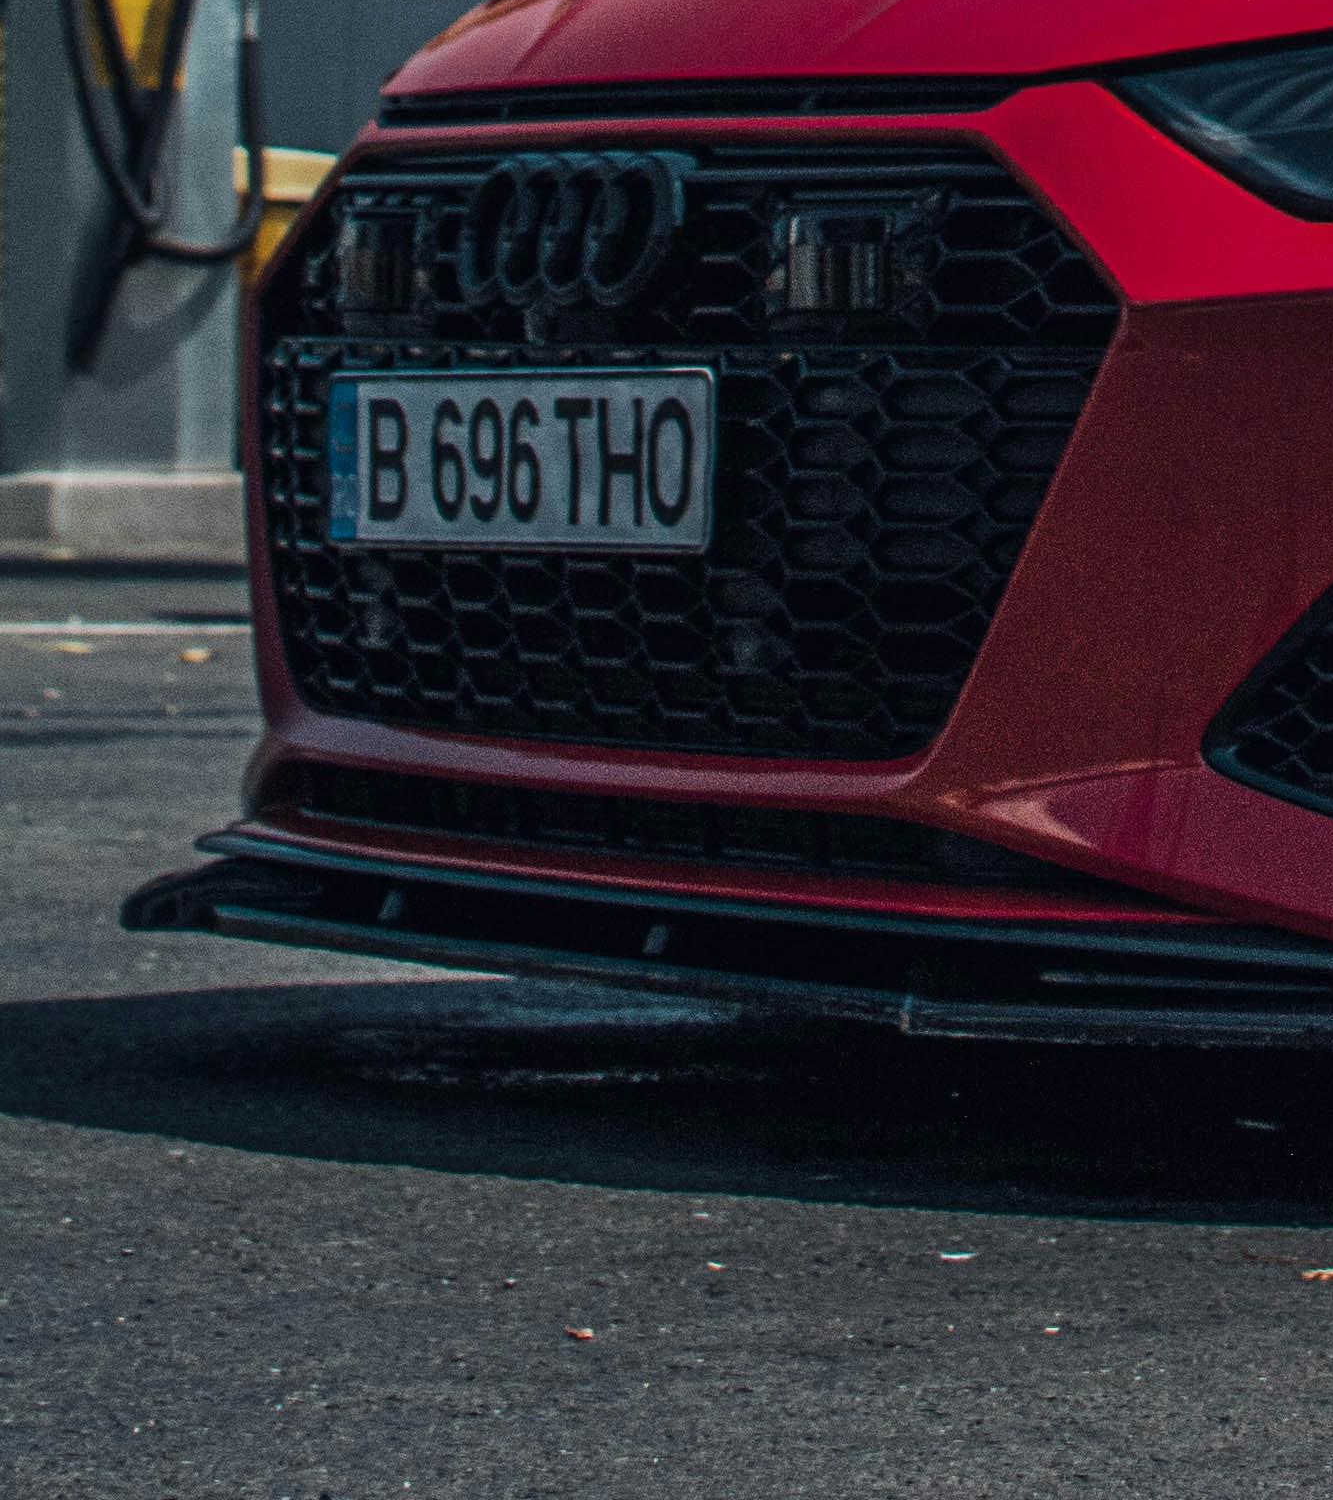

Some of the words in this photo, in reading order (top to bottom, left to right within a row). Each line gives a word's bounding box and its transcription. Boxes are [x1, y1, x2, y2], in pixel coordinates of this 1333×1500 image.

[368, 398, 410, 522] B
[432, 398, 542, 523] 696
[554, 397, 694, 527] THO
